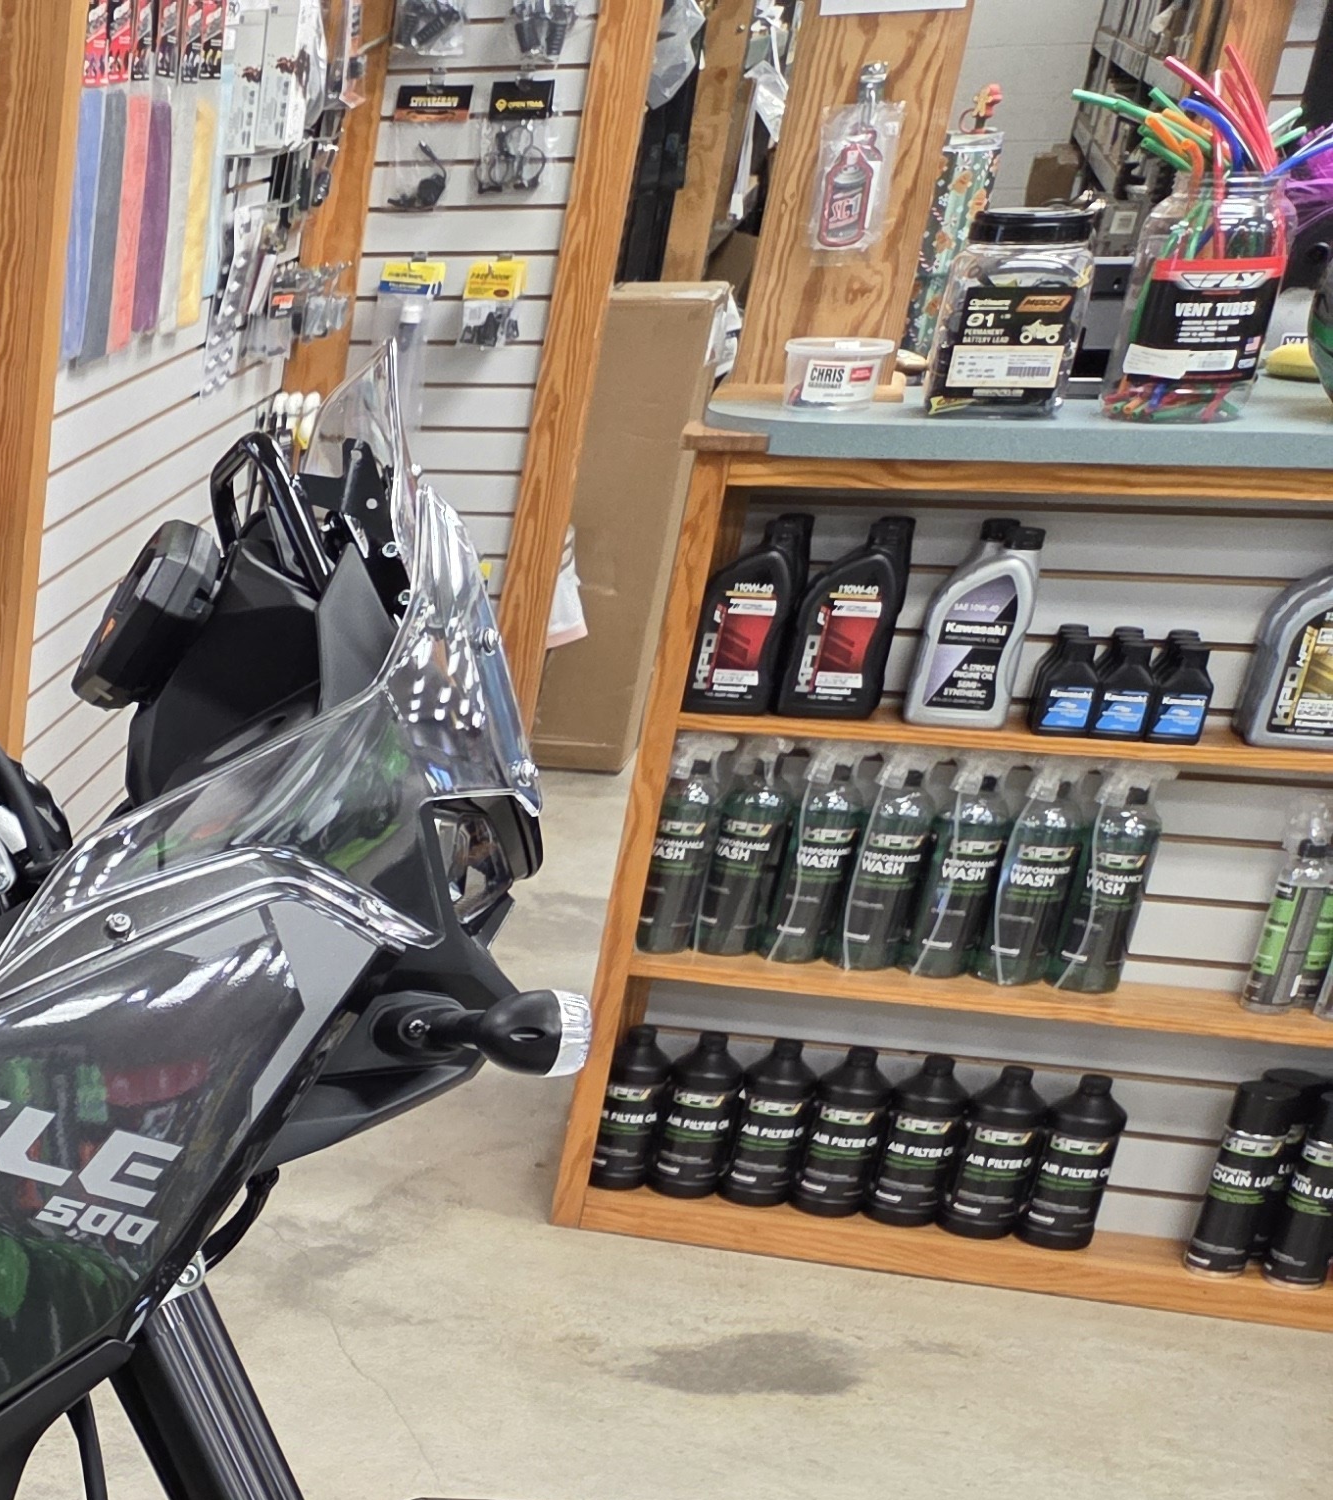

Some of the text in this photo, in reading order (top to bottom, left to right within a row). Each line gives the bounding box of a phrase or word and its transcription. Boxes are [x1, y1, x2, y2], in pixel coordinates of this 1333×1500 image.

[1175, 301, 1256, 317] VENT TUBES
[810, 367, 845, 382] CHRIS
[945, 622, 1007, 636] Kawasaki
[797, 853, 838, 868] WASH
[861, 859, 905, 875] WASH
[942, 865, 987, 881] WASH
[1010, 871, 1055, 888] WASH
[610, 1112, 644, 1124] FILTER
[666, 1114, 683, 1127] AIR
[682, 1118, 718, 1132] FILTER
[741, 1123, 760, 1136] AIR
[760, 1126, 795, 1139] FILTER
[812, 1131, 830, 1145] AIR
[830, 1135, 866, 1149] FILTER
[888, 1141, 906, 1154] AIR
[906, 1146, 943, 1158] FILTER
[966, 1153, 986, 1166] AIR
[986, 1158, 1023, 1169] FILTER
[1041, 1161, 1060, 1176] AIR
[1060, 1166, 1098, 1179] FILTER
[1213, 1168, 1252, 1188] CHAIN
[35, 1195, 160, 1245] 500
